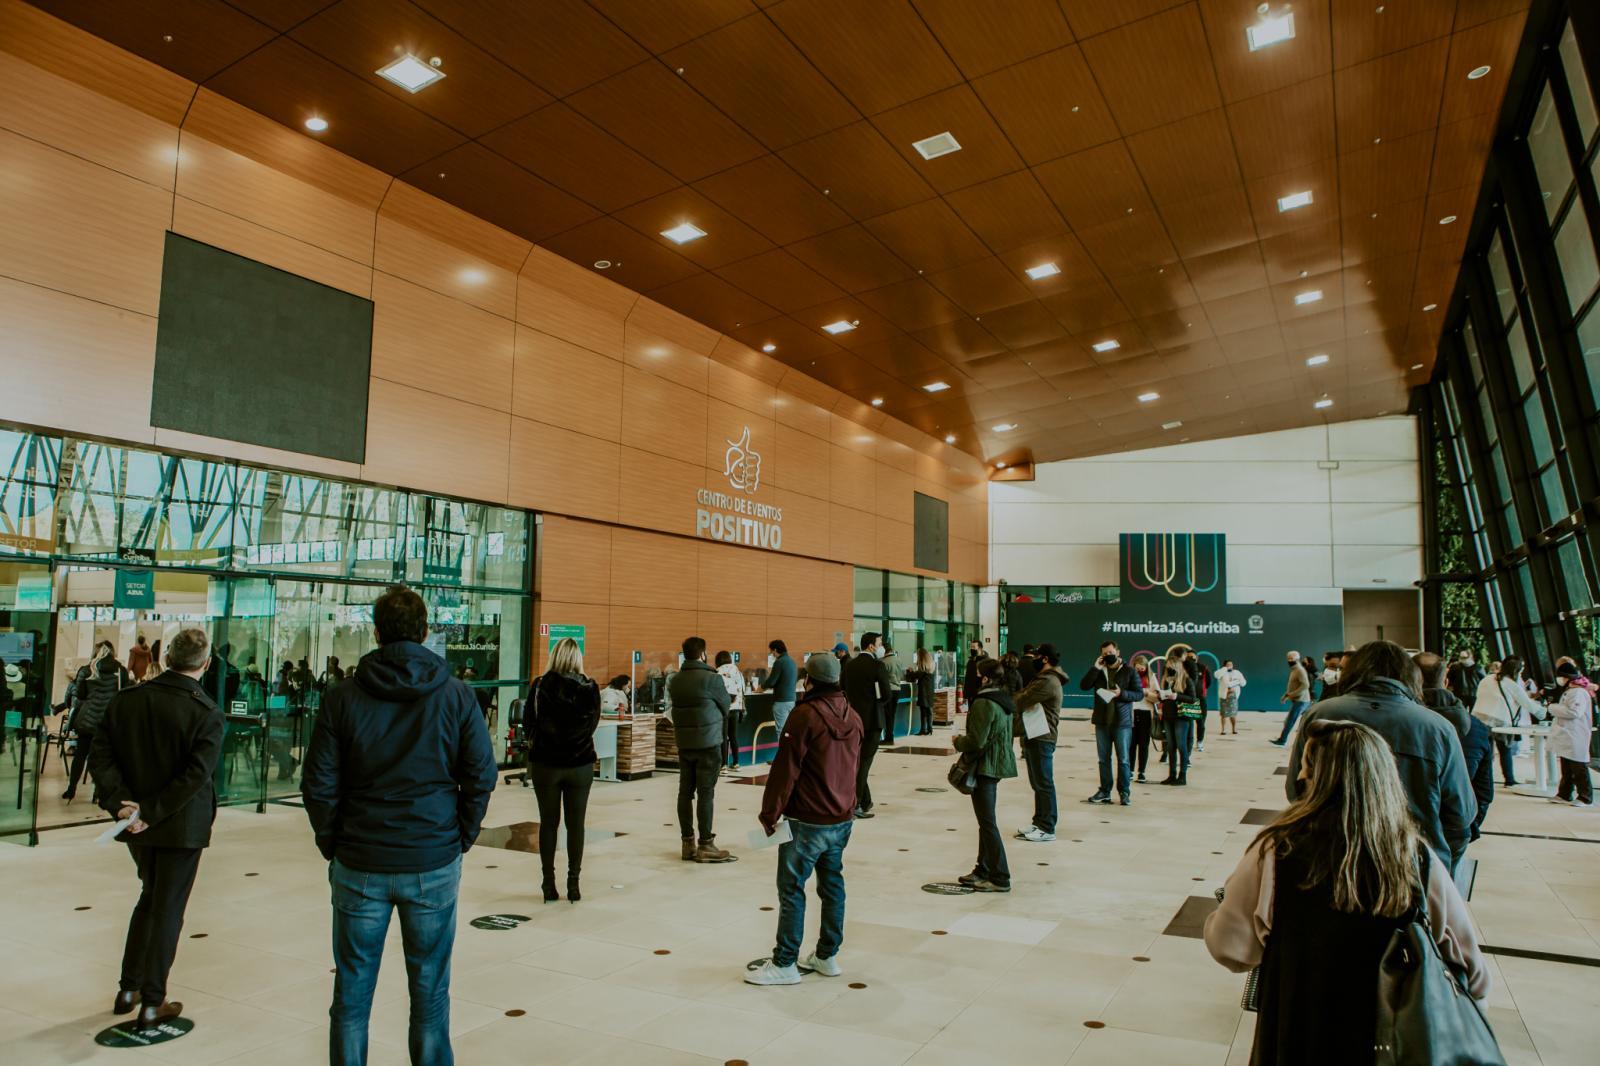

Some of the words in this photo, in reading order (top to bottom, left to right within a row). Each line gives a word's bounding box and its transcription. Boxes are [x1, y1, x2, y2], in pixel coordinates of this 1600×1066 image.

[697, 488, 733, 510] CENTRO
[734, 497, 746, 514] DE
[747, 500, 782, 522] EVENTOS
[696, 508, 782, 550] POSITIVO
[1102, 620, 1240, 634] #ImunizaJáCuritiba
